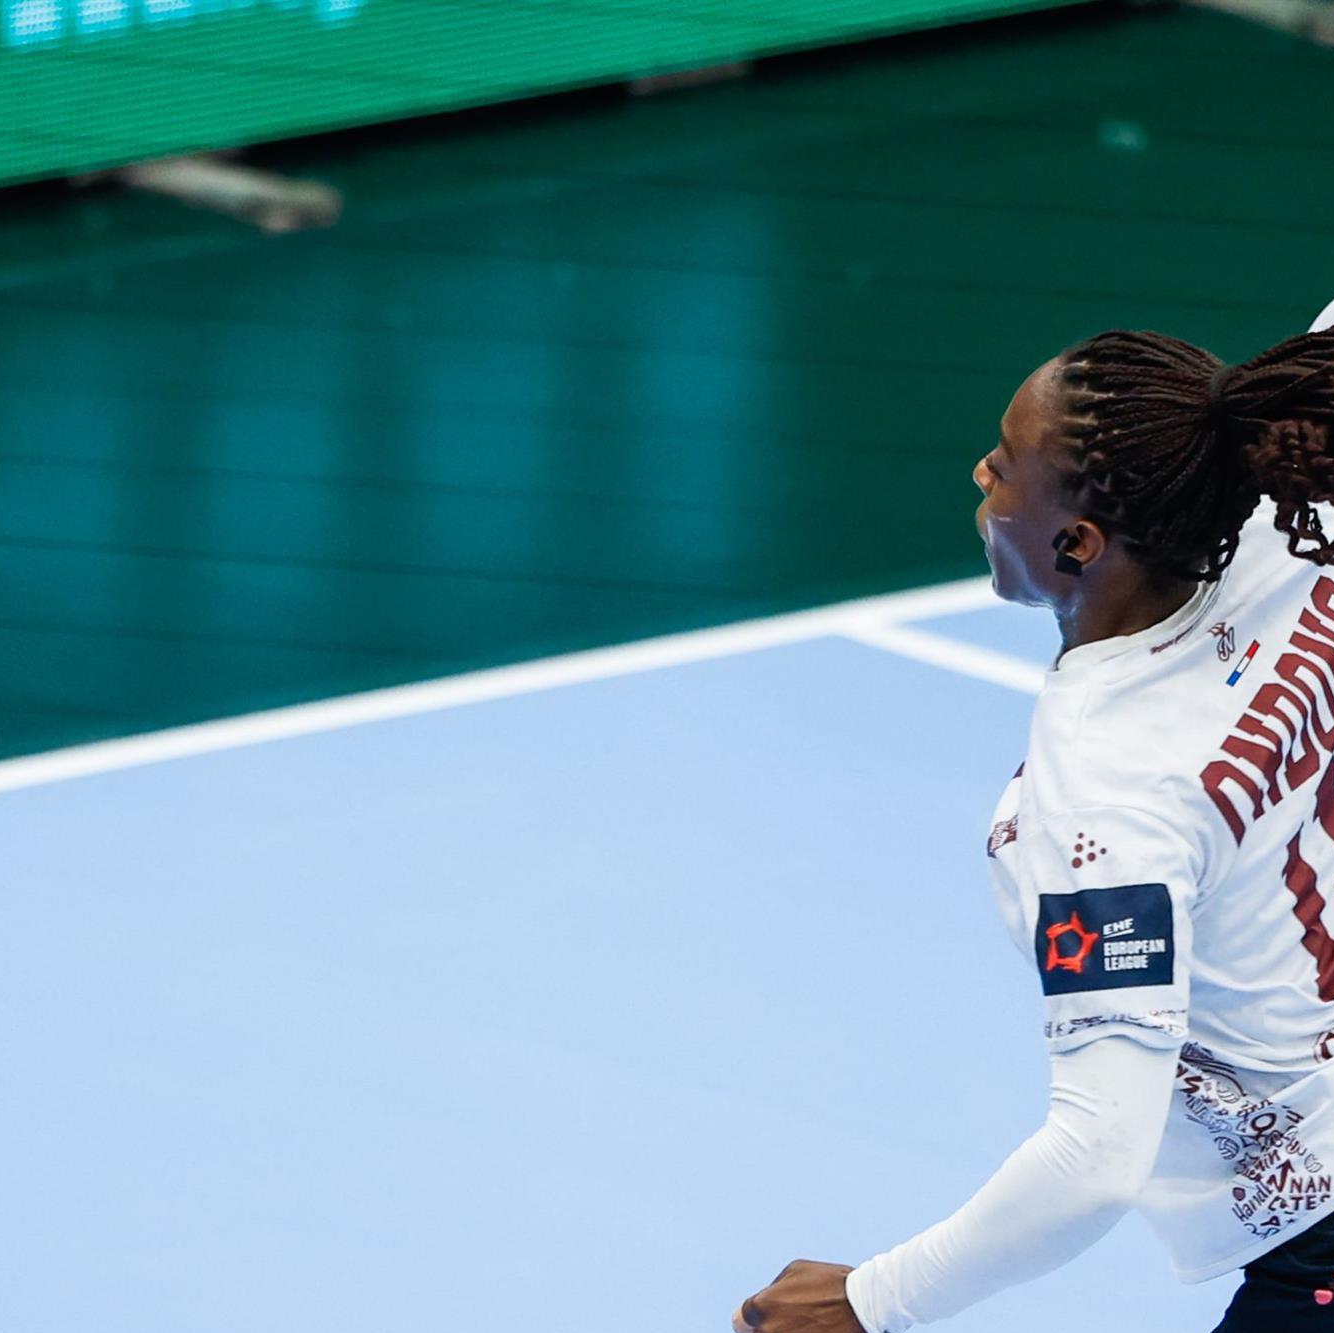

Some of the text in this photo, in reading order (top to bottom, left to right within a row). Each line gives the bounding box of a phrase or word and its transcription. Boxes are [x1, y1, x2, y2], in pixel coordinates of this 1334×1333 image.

[1102, 917, 1135, 936] EHF
[1104, 939, 1165, 956] EUROPEAN
[1104, 955, 1148, 971] LEAGUE
